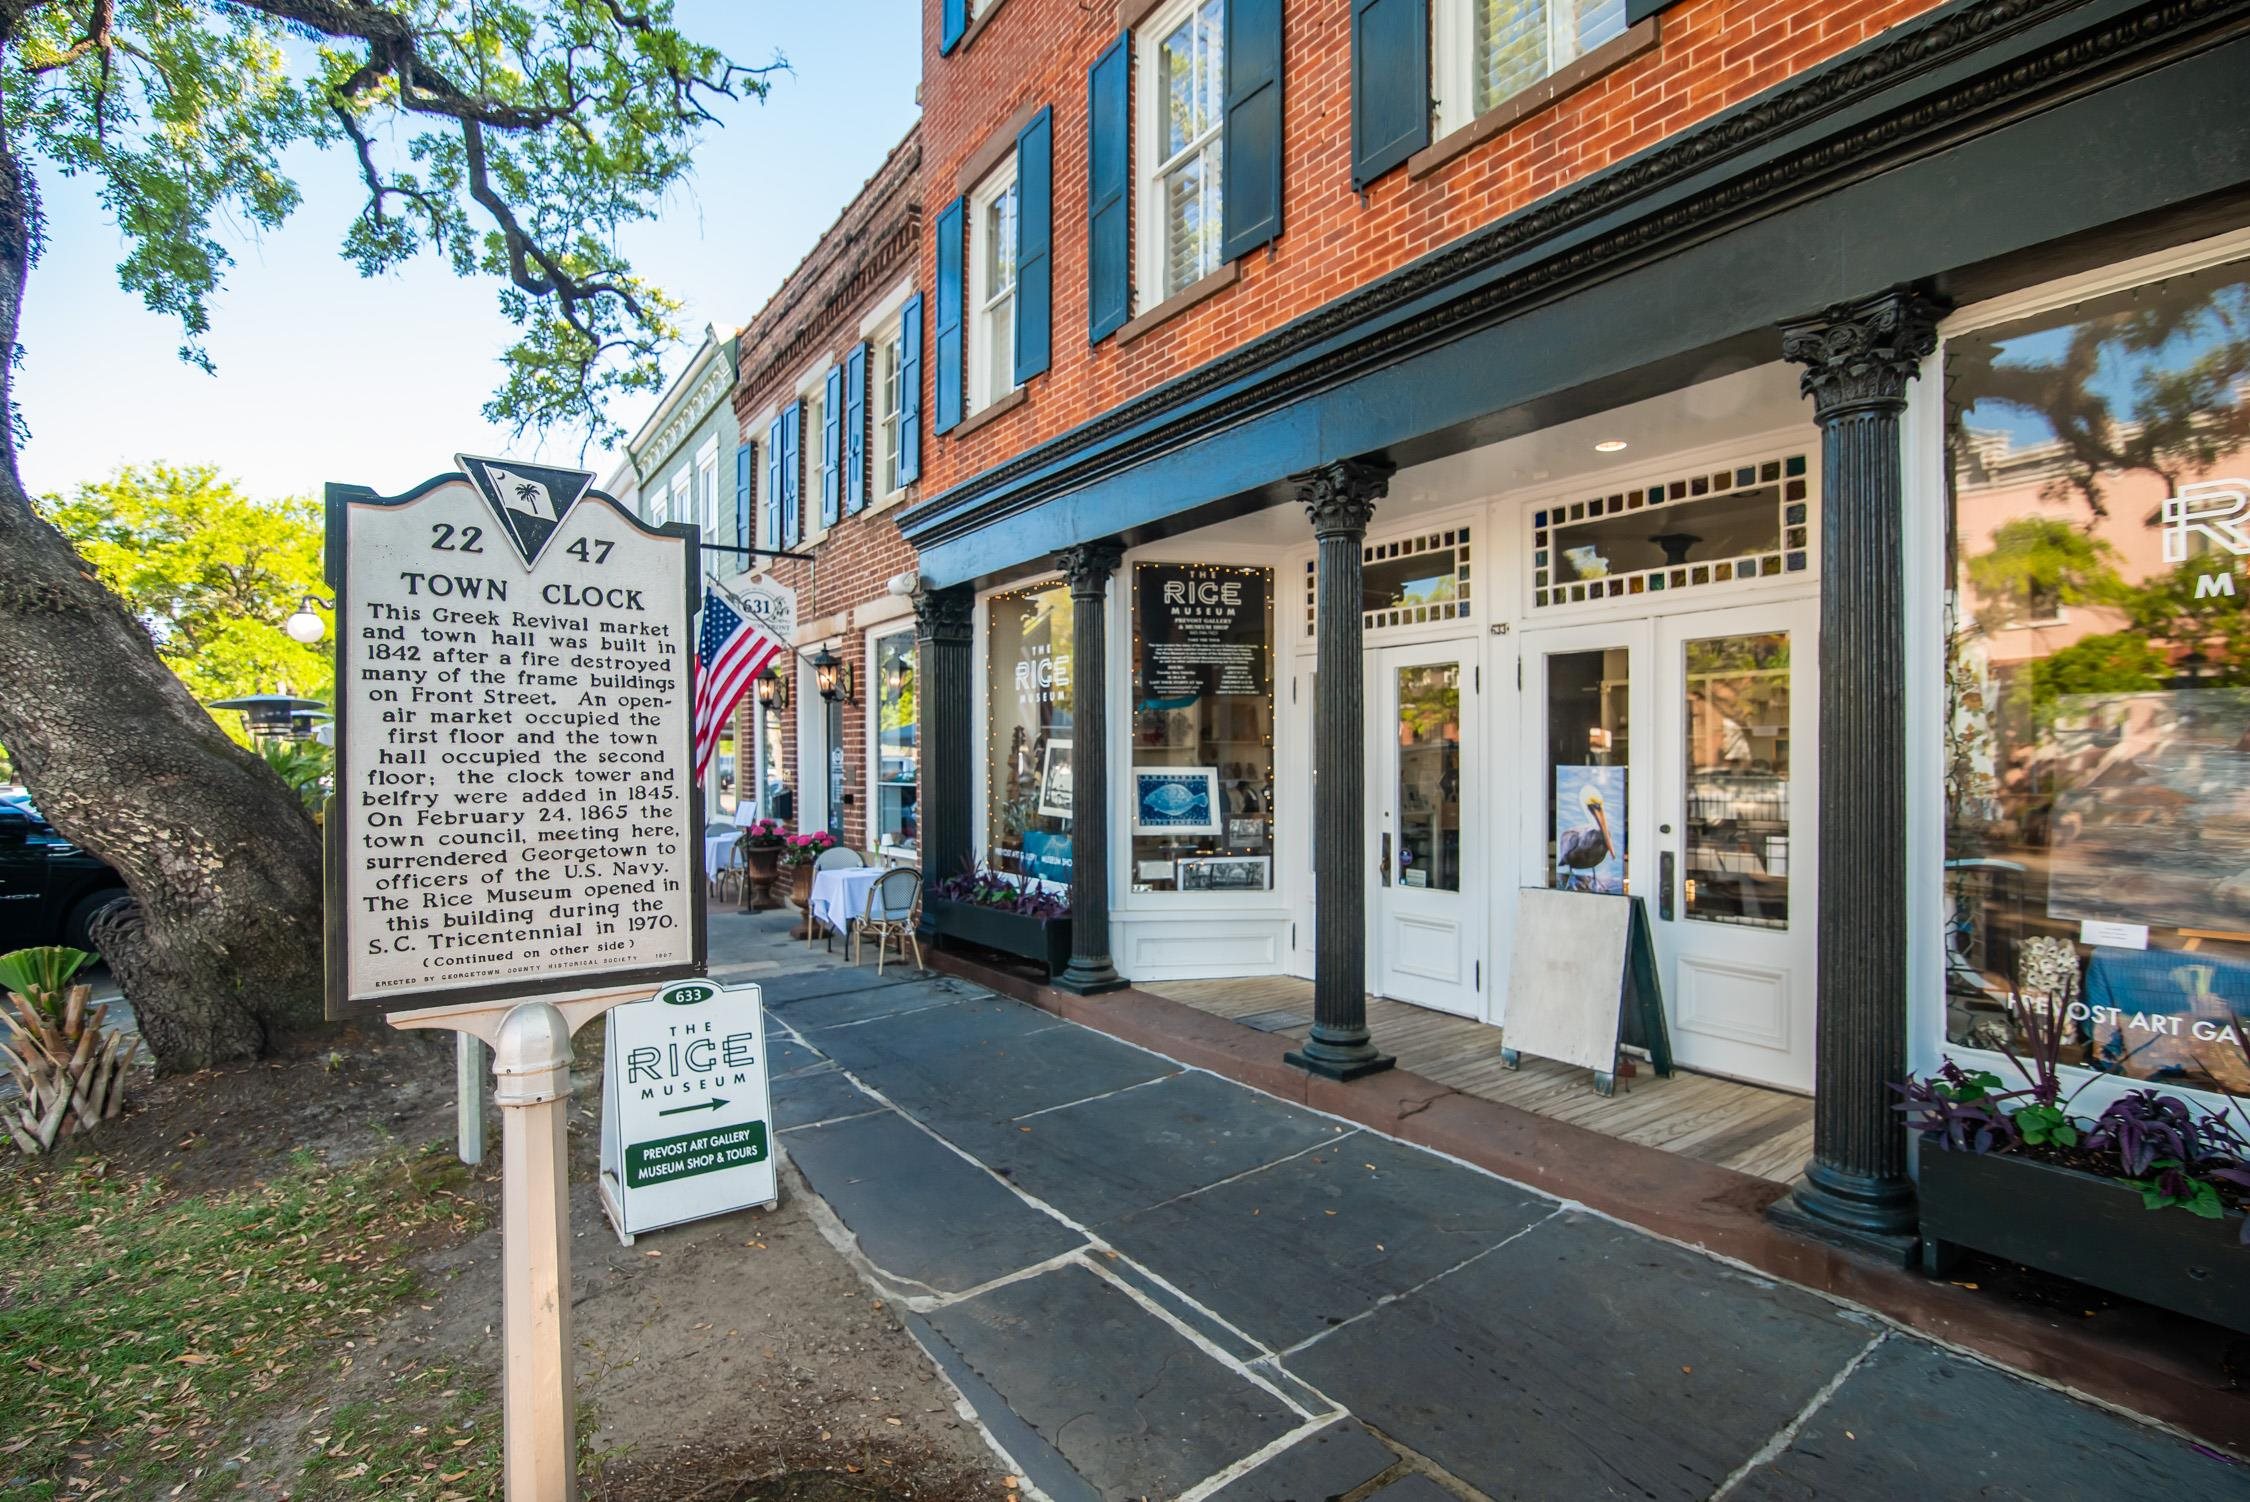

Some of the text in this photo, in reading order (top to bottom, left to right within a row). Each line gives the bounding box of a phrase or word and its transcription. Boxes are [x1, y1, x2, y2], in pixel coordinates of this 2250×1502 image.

[431, 523, 484, 554] 22
[565, 536, 616, 565] 47
[1189, 570, 1217, 579] THE
[400, 571, 645, 611] TOWN CLOCK
[1163, 581, 1242, 605] RICE
[367, 602, 669, 637] This Greek Revival market
[743, 599, 770, 614] 631
[1170, 607, 1236, 616] MUSEUM
[362, 625, 676, 655] and town hall was built in
[1031, 644, 1051, 656] THE
[368, 643, 671, 674] 1842 after a fire destroyed
[361, 667, 676, 694] many of the frame buildings
[1015, 655, 1070, 691] RICE
[368, 686, 672, 710] on Front Street. An open-
[1020, 690, 1065, 704] MUSEUM
[382, 707, 661, 728] air market occupied the
[387, 727, 658, 745] first floor and the town
[379, 748, 665, 767] hall occupied the second
[367, 767, 675, 787] floor; the clock tower and
[362, 784, 679, 809] belfry were added in 1845.
[367, 811, 403, 828] On
[417, 809, 525, 826] February
[581, 804, 628, 821] 1865
[640, 804, 673, 819] the
[362, 823, 680, 849] town council, meeting here,
[366, 842, 676, 871] surrendered Georgetown to
[375, 861, 669, 891] officers of the U.S. Navy.
[362, 878, 680, 913] The Rice Museum opened in
[385, 898, 663, 932] this building during the
[427, 923, 583, 951] Tricentennial
[596, 921, 615, 935] in
[628, 914, 678, 932] 1970.
[523, 950, 540, 959] on
[549, 945, 589, 956] other
[375, 977, 417, 988] ERECTED
[423, 975, 435, 983] BY
[441, 969, 500, 981] GEORGETOWN
[674, 990, 702, 1004] 633
[670, 1021, 712, 1037] THE
[2007, 992, 2250, 1046] PEOST ART GA
[627, 1032, 755, 1084] RICE
[641, 1072, 746, 1100] MUSEUM
[643, 1129, 750, 1161] PREVOST ART GALLERY
[638, 1144, 758, 1180] MUSEUM SHOP & TOURS
